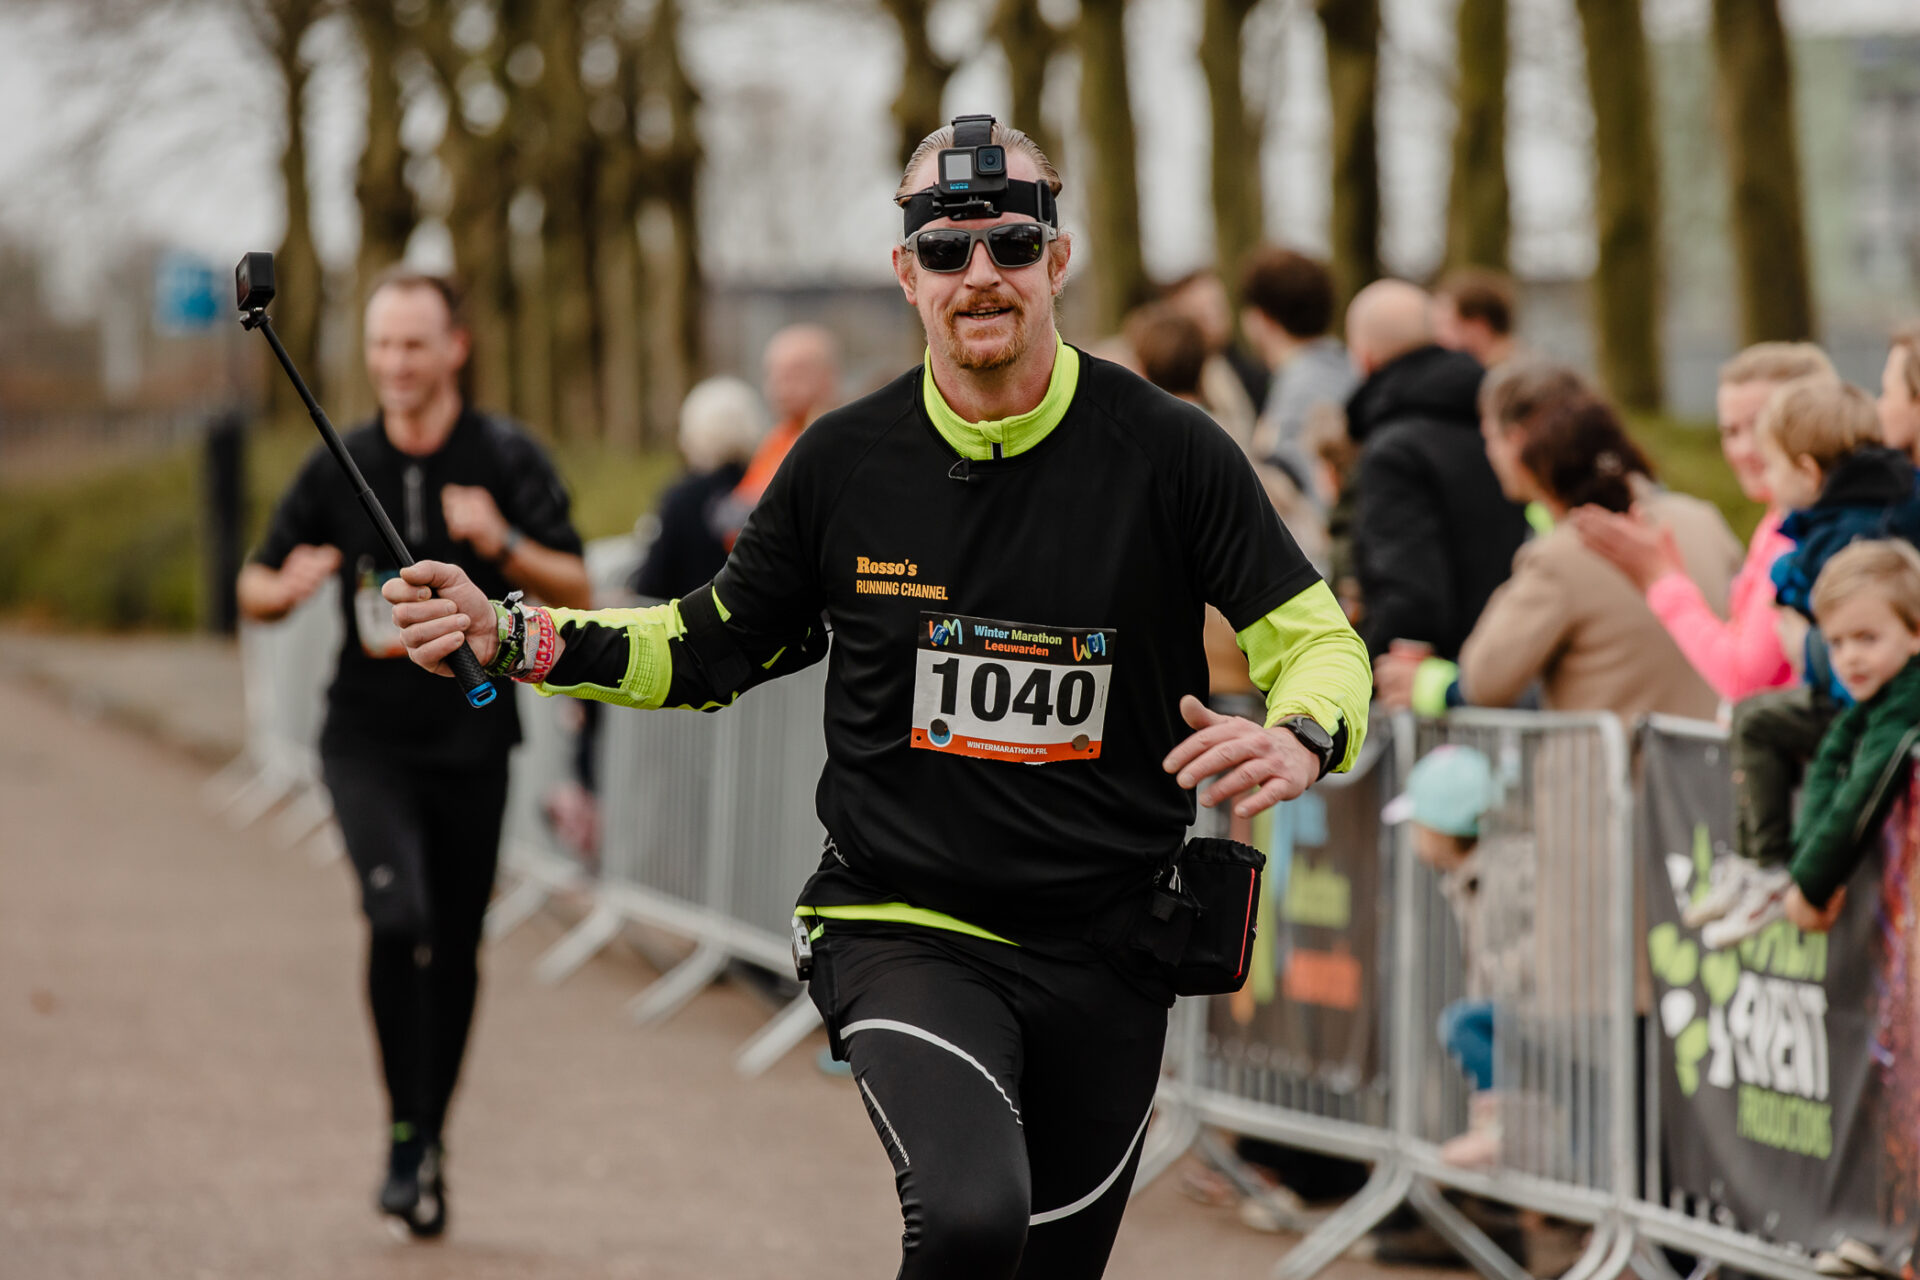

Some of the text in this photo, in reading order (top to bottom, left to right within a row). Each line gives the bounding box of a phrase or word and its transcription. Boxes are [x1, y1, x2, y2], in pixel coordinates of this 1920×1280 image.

[856, 556, 918, 576] Rosso's
[856, 580, 949, 600] RUNNING CHANNEL
[974, 625, 1063, 645] Winter Marathon
[985, 640, 1049, 656] Leeuwarden
[932, 657, 1096, 726] 1040
[966, 740, 1048, 755] WINTERMARATHON.FRL
